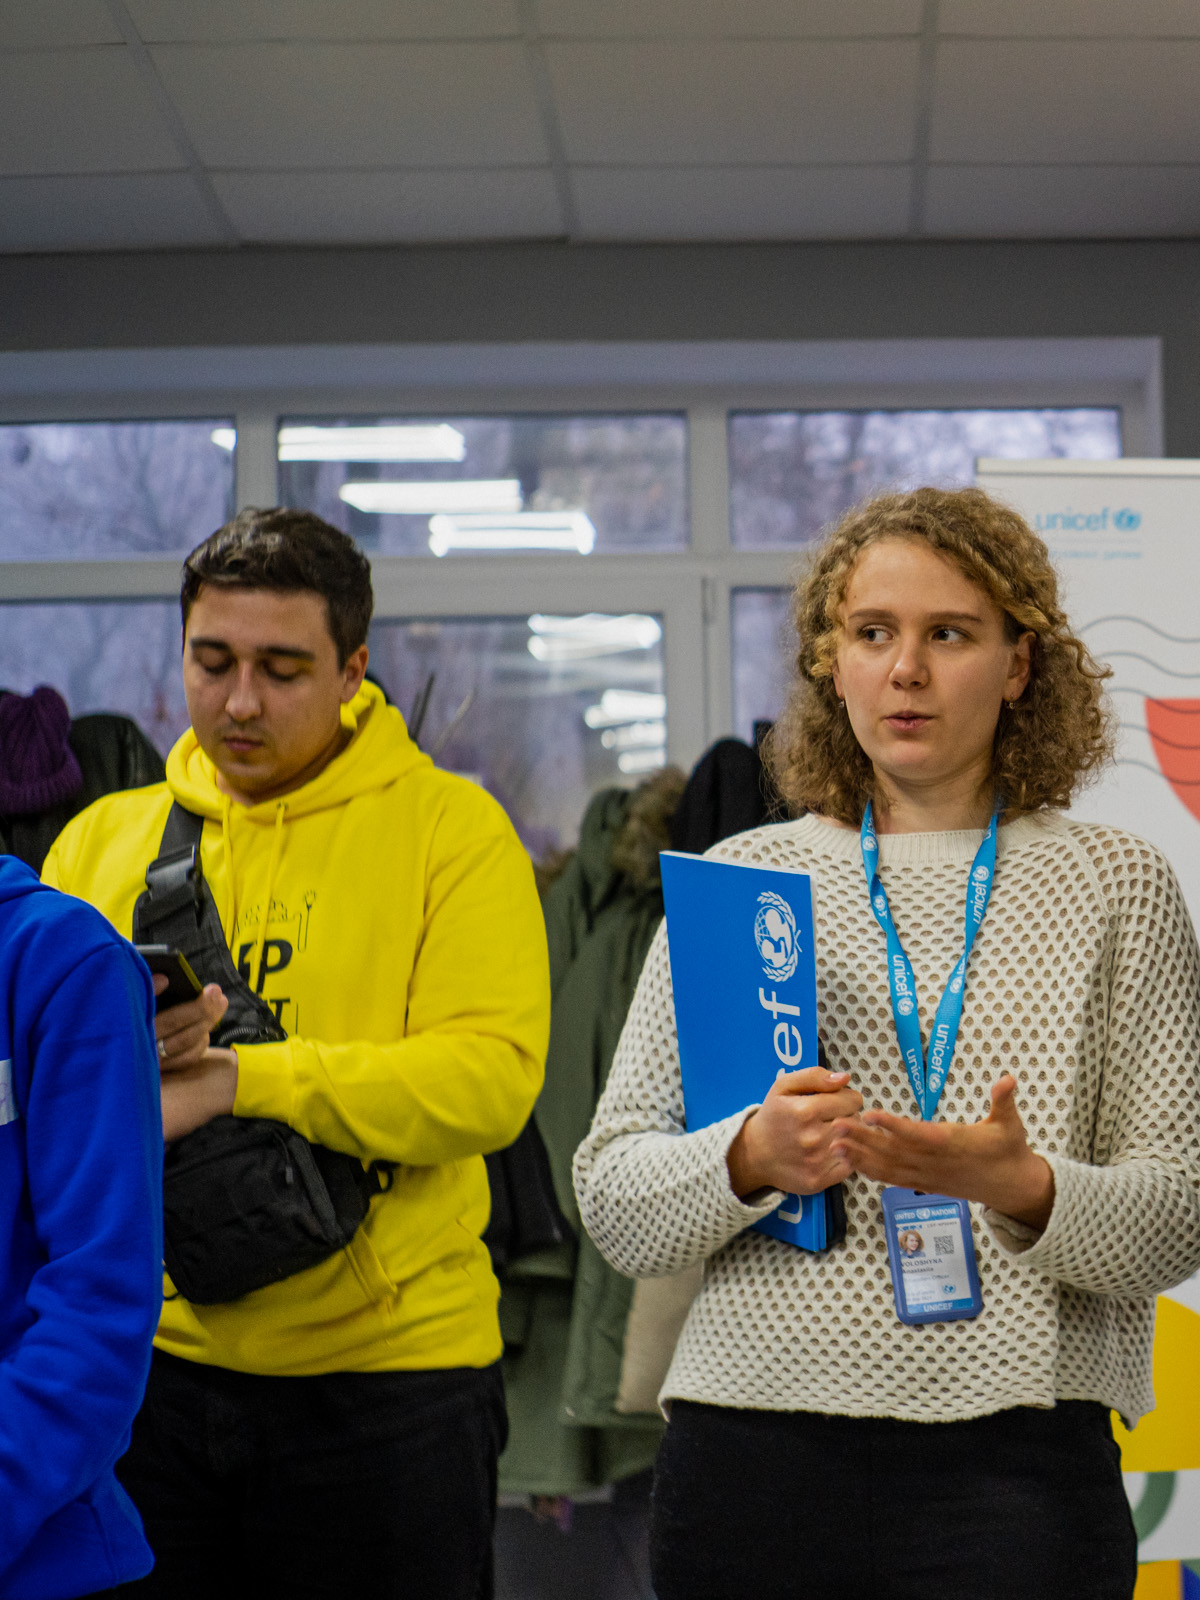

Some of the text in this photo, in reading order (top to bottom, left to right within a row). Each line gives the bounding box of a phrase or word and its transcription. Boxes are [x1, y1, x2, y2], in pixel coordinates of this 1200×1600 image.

[1036, 506, 1110, 531] unicef
[972, 881, 988, 925] unicef
[892, 954, 913, 999] unicef
[931, 1024, 950, 1076] unicef
[923, 1303, 953, 1313] UNICEF
